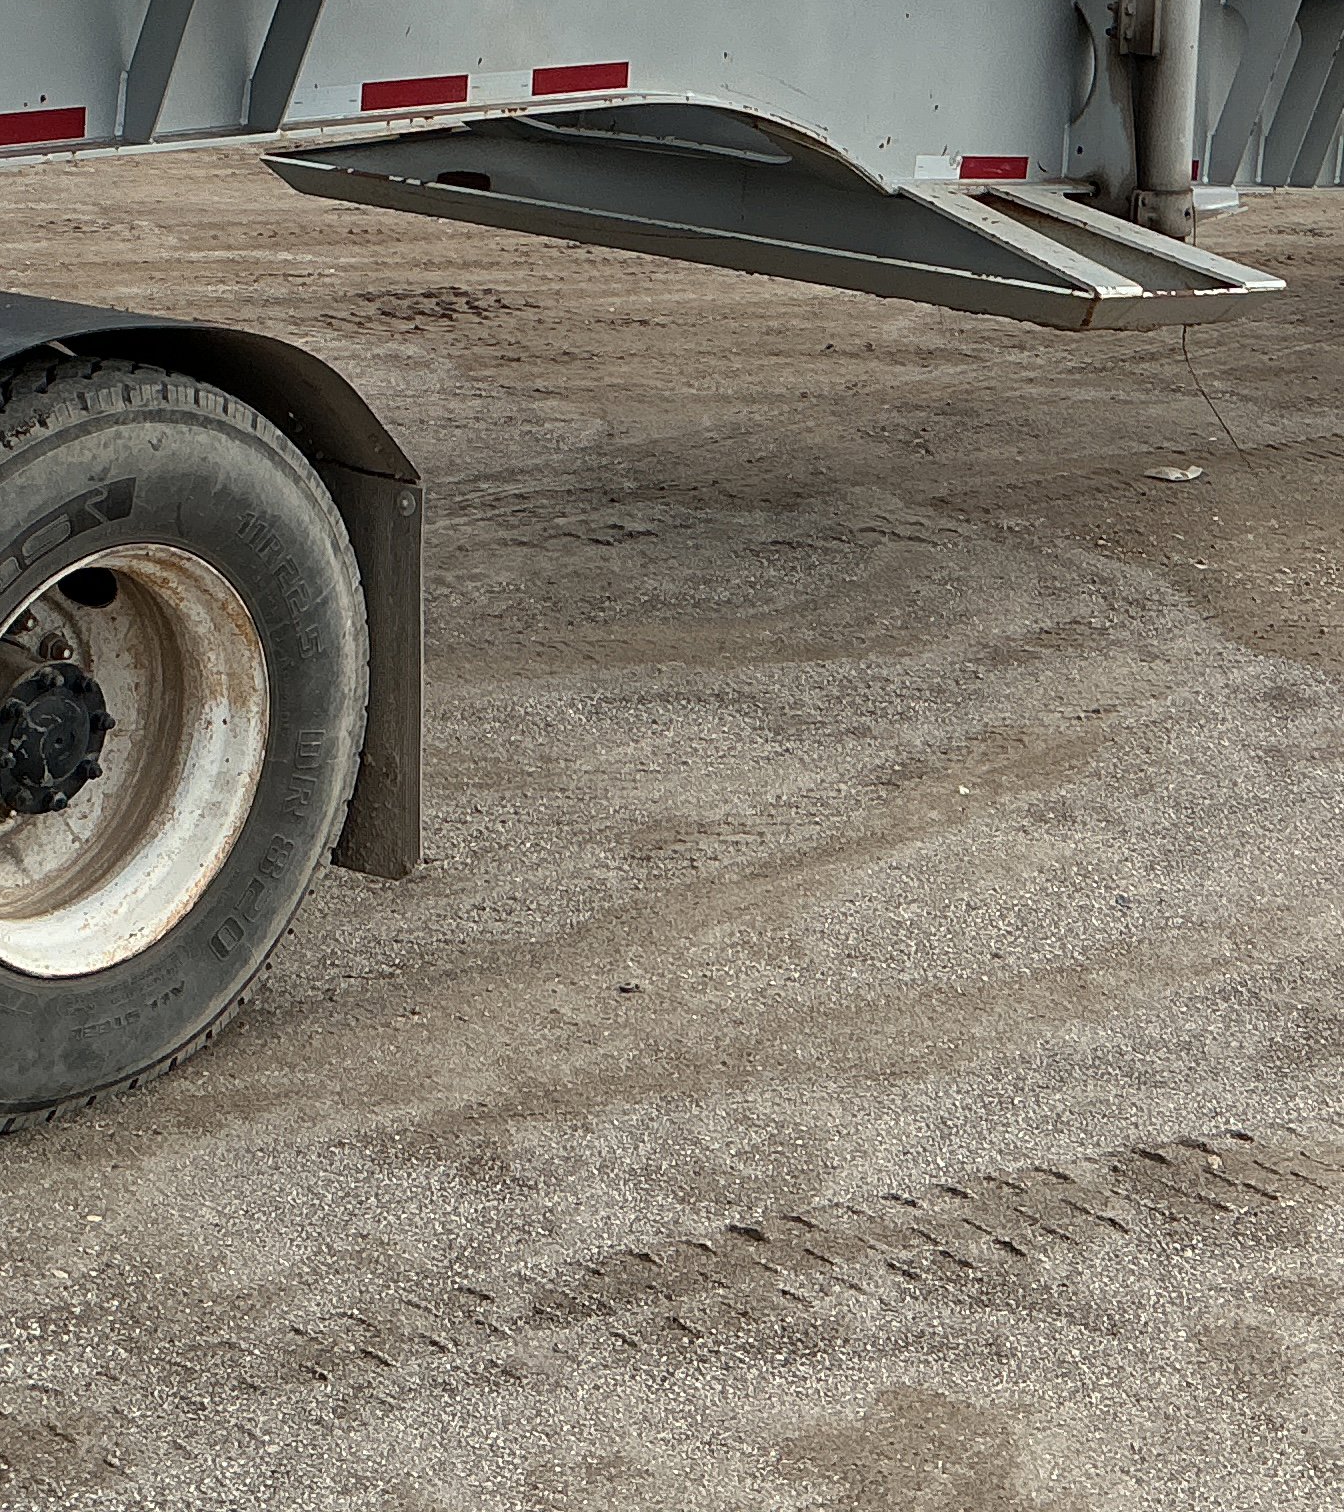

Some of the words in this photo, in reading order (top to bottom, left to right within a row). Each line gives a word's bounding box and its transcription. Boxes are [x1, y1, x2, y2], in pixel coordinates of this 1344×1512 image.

[233, 508, 324, 662] 11R22.5
[283, 727, 327, 819] DR
[208, 835, 296, 963] 820
